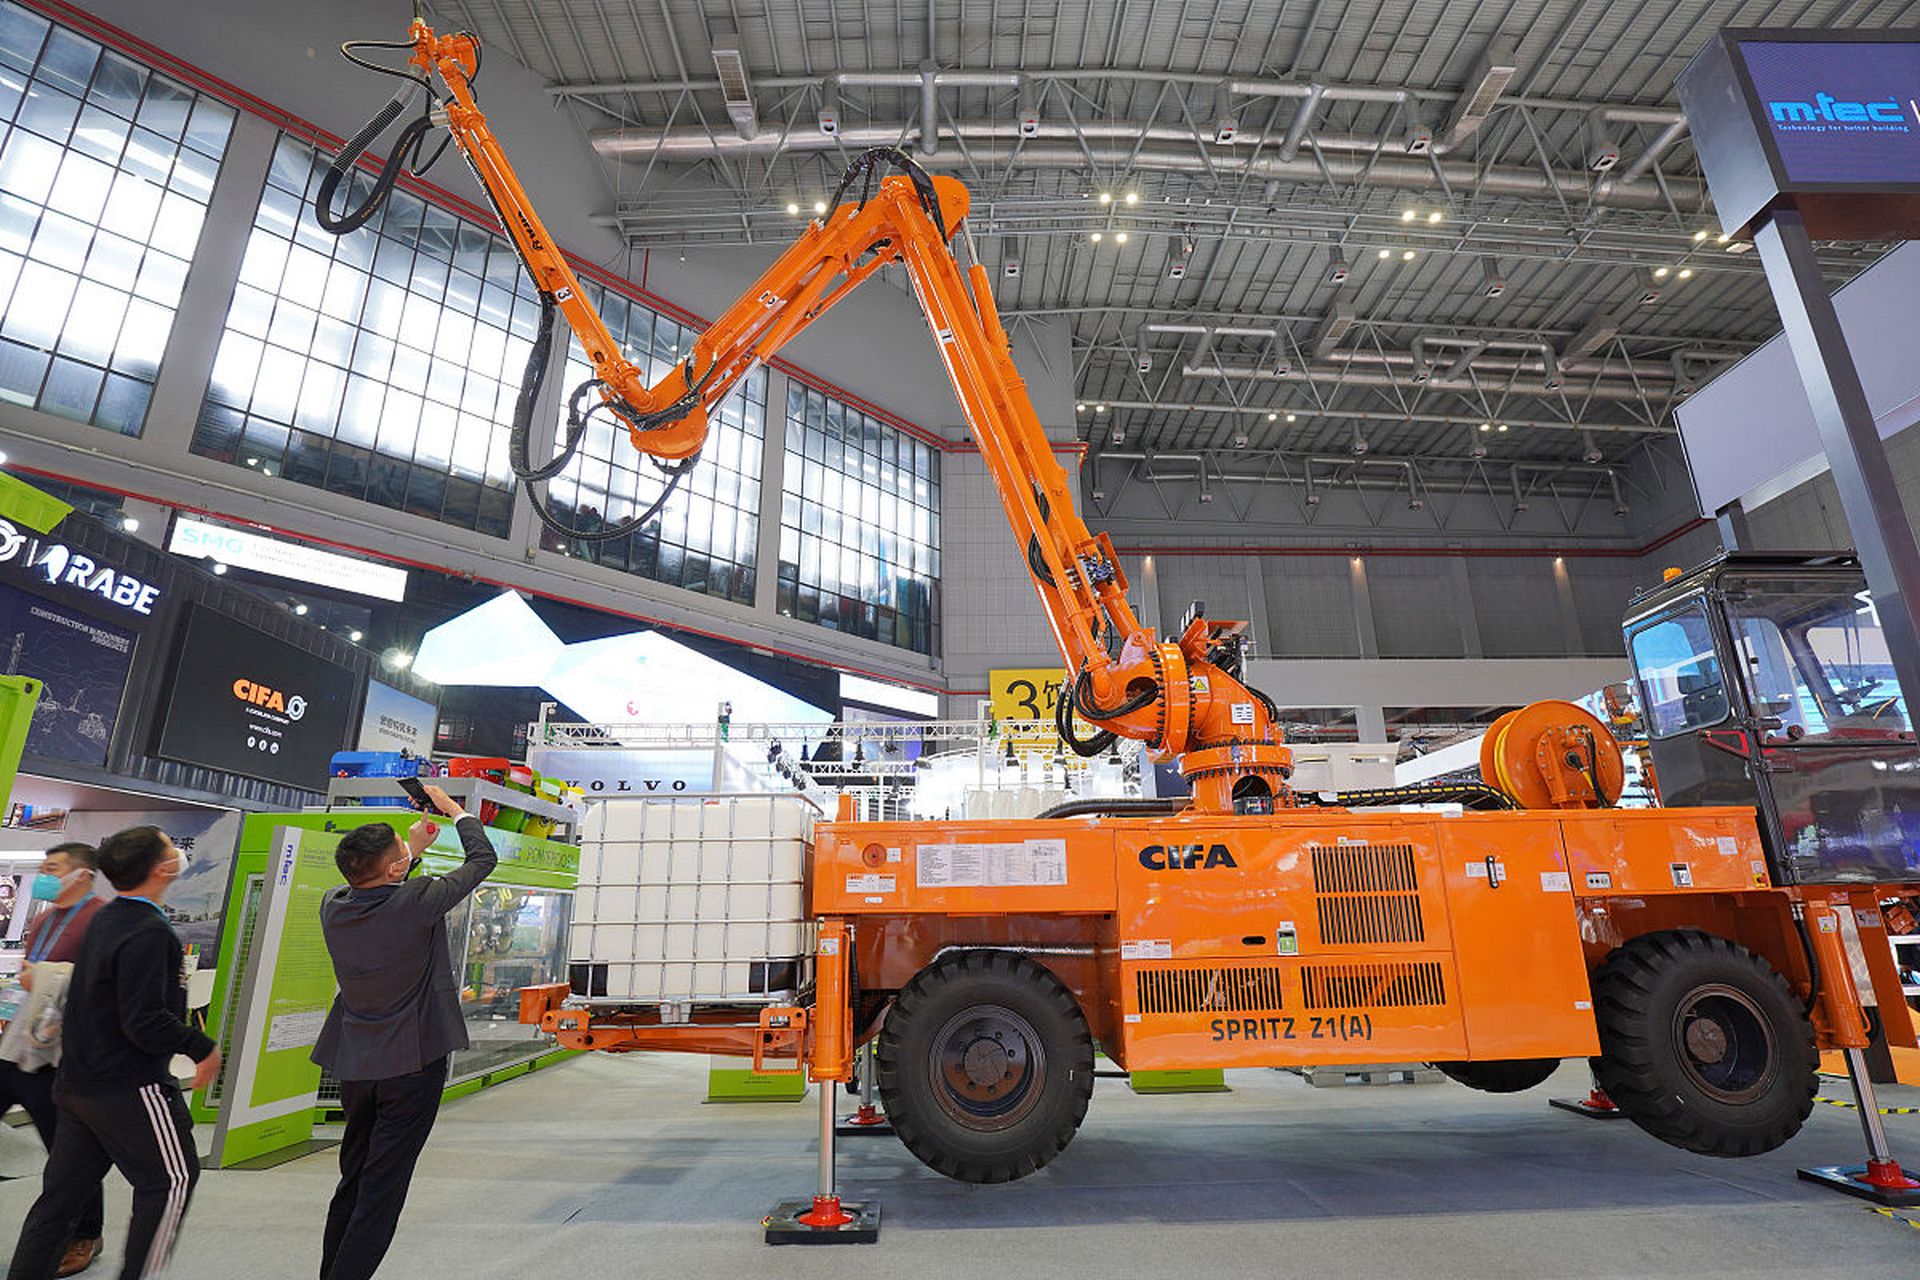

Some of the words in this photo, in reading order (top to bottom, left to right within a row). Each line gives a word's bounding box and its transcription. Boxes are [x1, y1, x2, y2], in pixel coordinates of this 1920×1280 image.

[1777, 124, 1826, 133] Technology
[1829, 124, 1841, 132] for
[1844, 124, 1870, 132] better
[558, 288, 571, 300] 3
[182, 526, 244, 554] SMG
[233, 679, 285, 713] CIFA
[1139, 844, 1237, 871] CIFA
[1211, 1017, 1297, 1042] SPRITZ
[1311, 1013, 1373, 1042] Z1(A)
